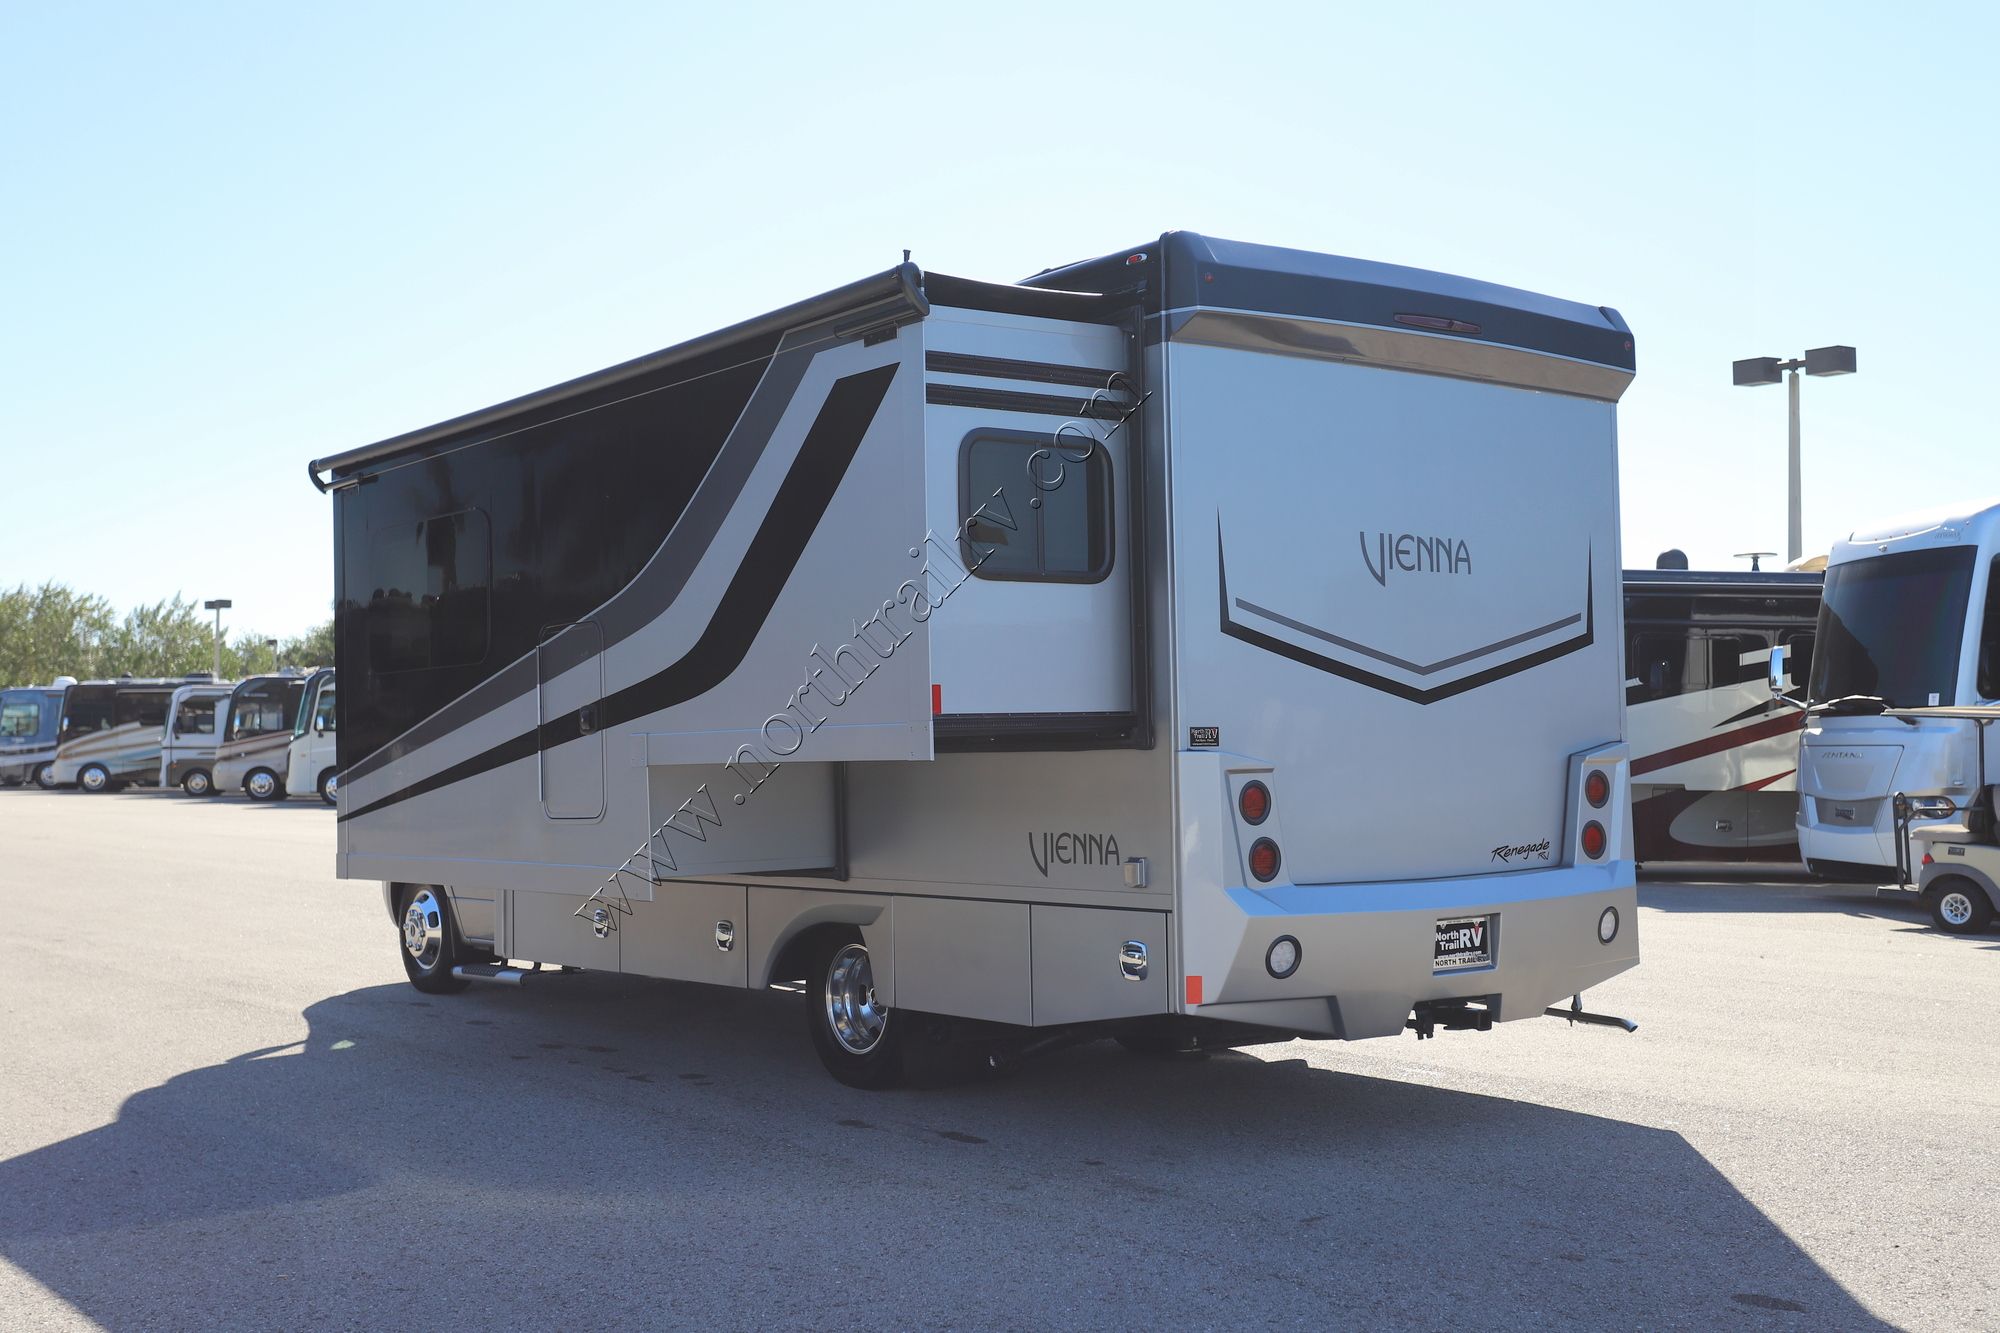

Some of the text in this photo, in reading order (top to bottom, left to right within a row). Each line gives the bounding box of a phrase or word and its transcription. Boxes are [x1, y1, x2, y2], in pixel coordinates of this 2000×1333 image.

[1359, 531, 1472, 588] VIENNA
[1028, 831, 1120, 878] VIENNA
[1491, 838, 1550, 863] Renegade
[1436, 931, 1458, 941] North
[1440, 940, 1459, 950] Trail
[1459, 928, 1483, 948] RV
[1435, 959, 1456, 967] NORTH
[1458, 957, 1476, 965] TRAIL
